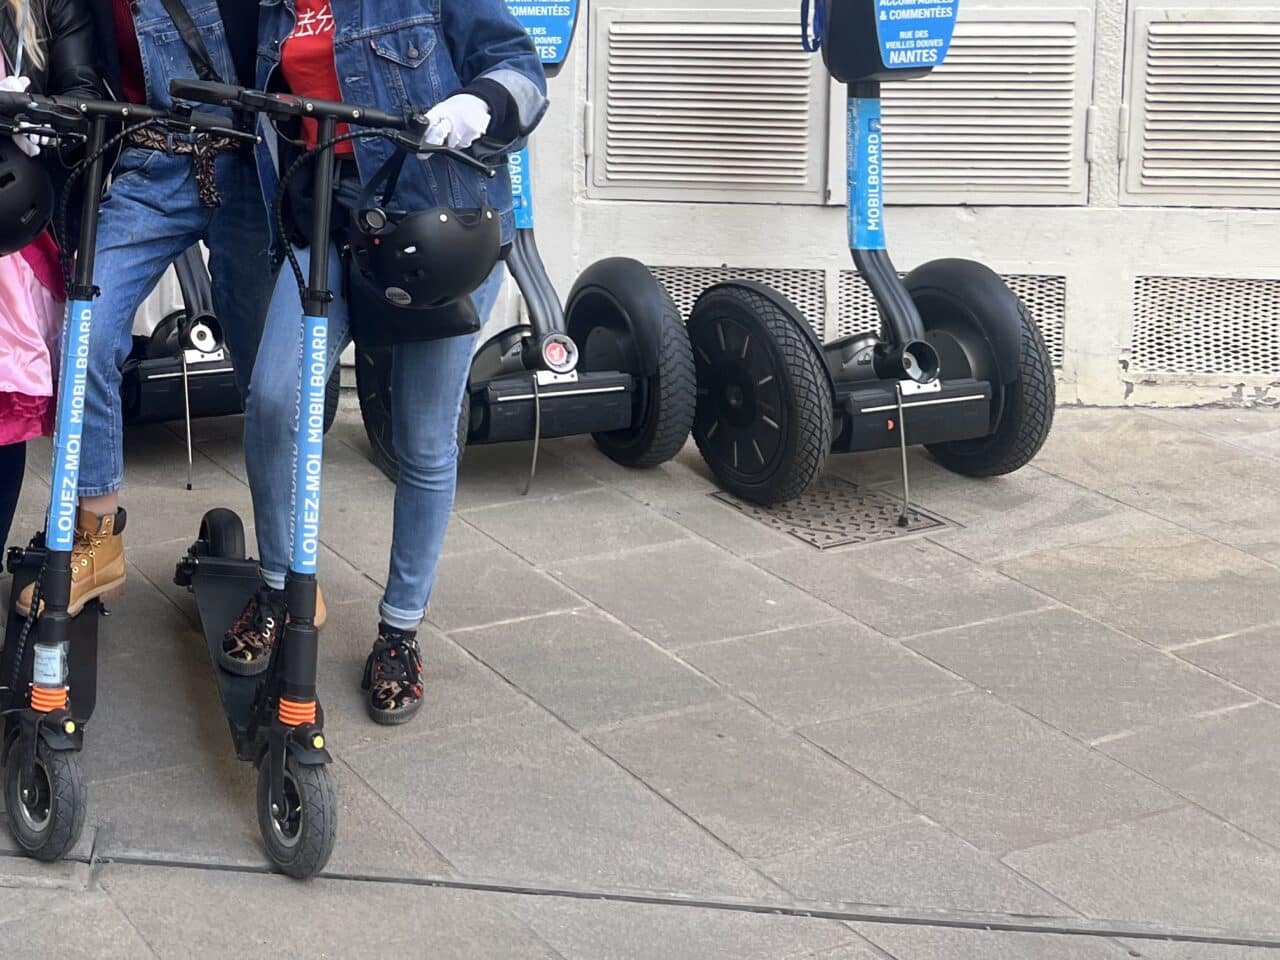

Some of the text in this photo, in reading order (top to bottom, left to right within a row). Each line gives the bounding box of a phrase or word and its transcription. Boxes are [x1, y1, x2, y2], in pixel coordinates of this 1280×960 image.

[889, 6, 953, 20] COMMENTÉES
[889, 48, 938, 64] NANTES
[867, 134, 880, 231] MOBILBOARD
[56, 432, 81, 544] LOUEZ-MOI
[72, 308, 92, 424] MOBILBOARD
[301, 325, 327, 566] LOUEZ-MOI MOBILBOARD
